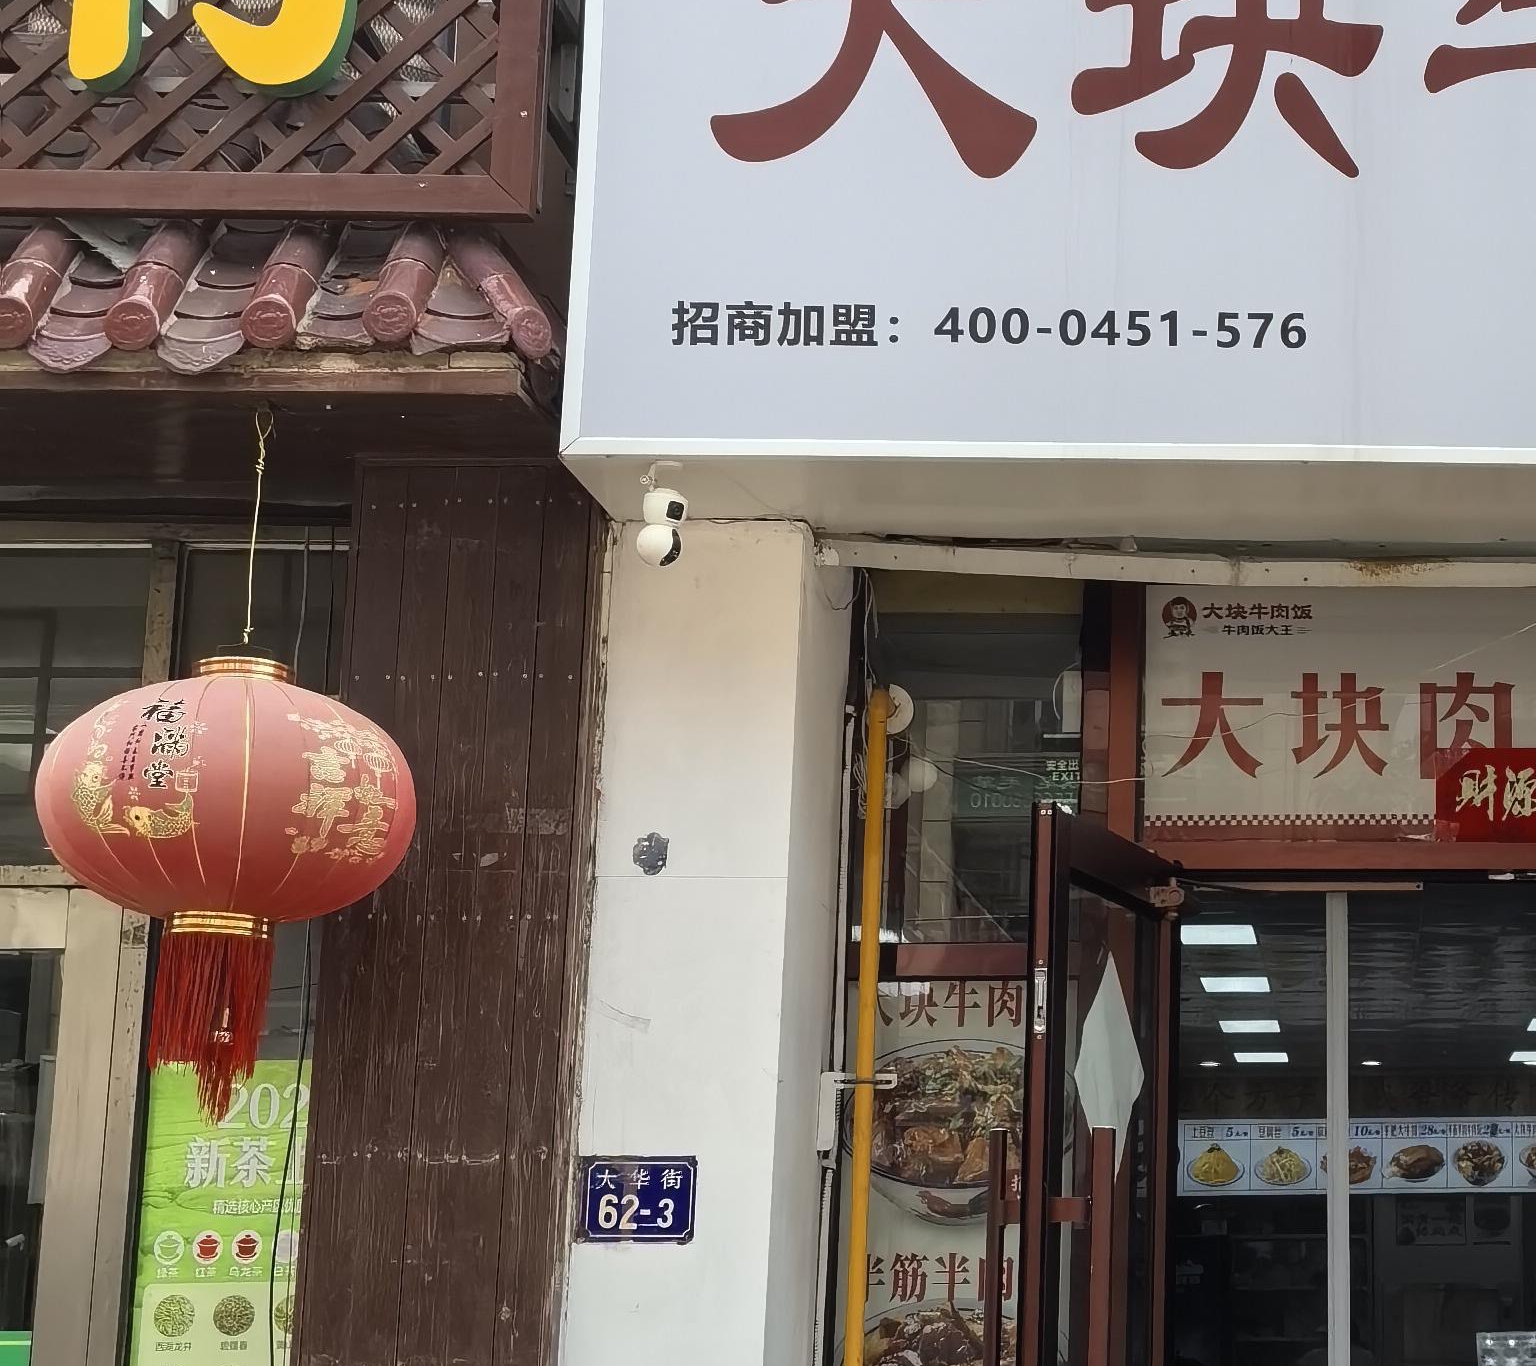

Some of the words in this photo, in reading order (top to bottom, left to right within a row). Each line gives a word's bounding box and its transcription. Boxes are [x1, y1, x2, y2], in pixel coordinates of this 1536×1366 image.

[1201, 602, 1313, 620] 大块牛肉饭
[1221, 624, 1294, 636] 牛肉饭大王
[590, 1168, 684, 1191] 大华街
[598, 1193, 675, 1230] 62-3
